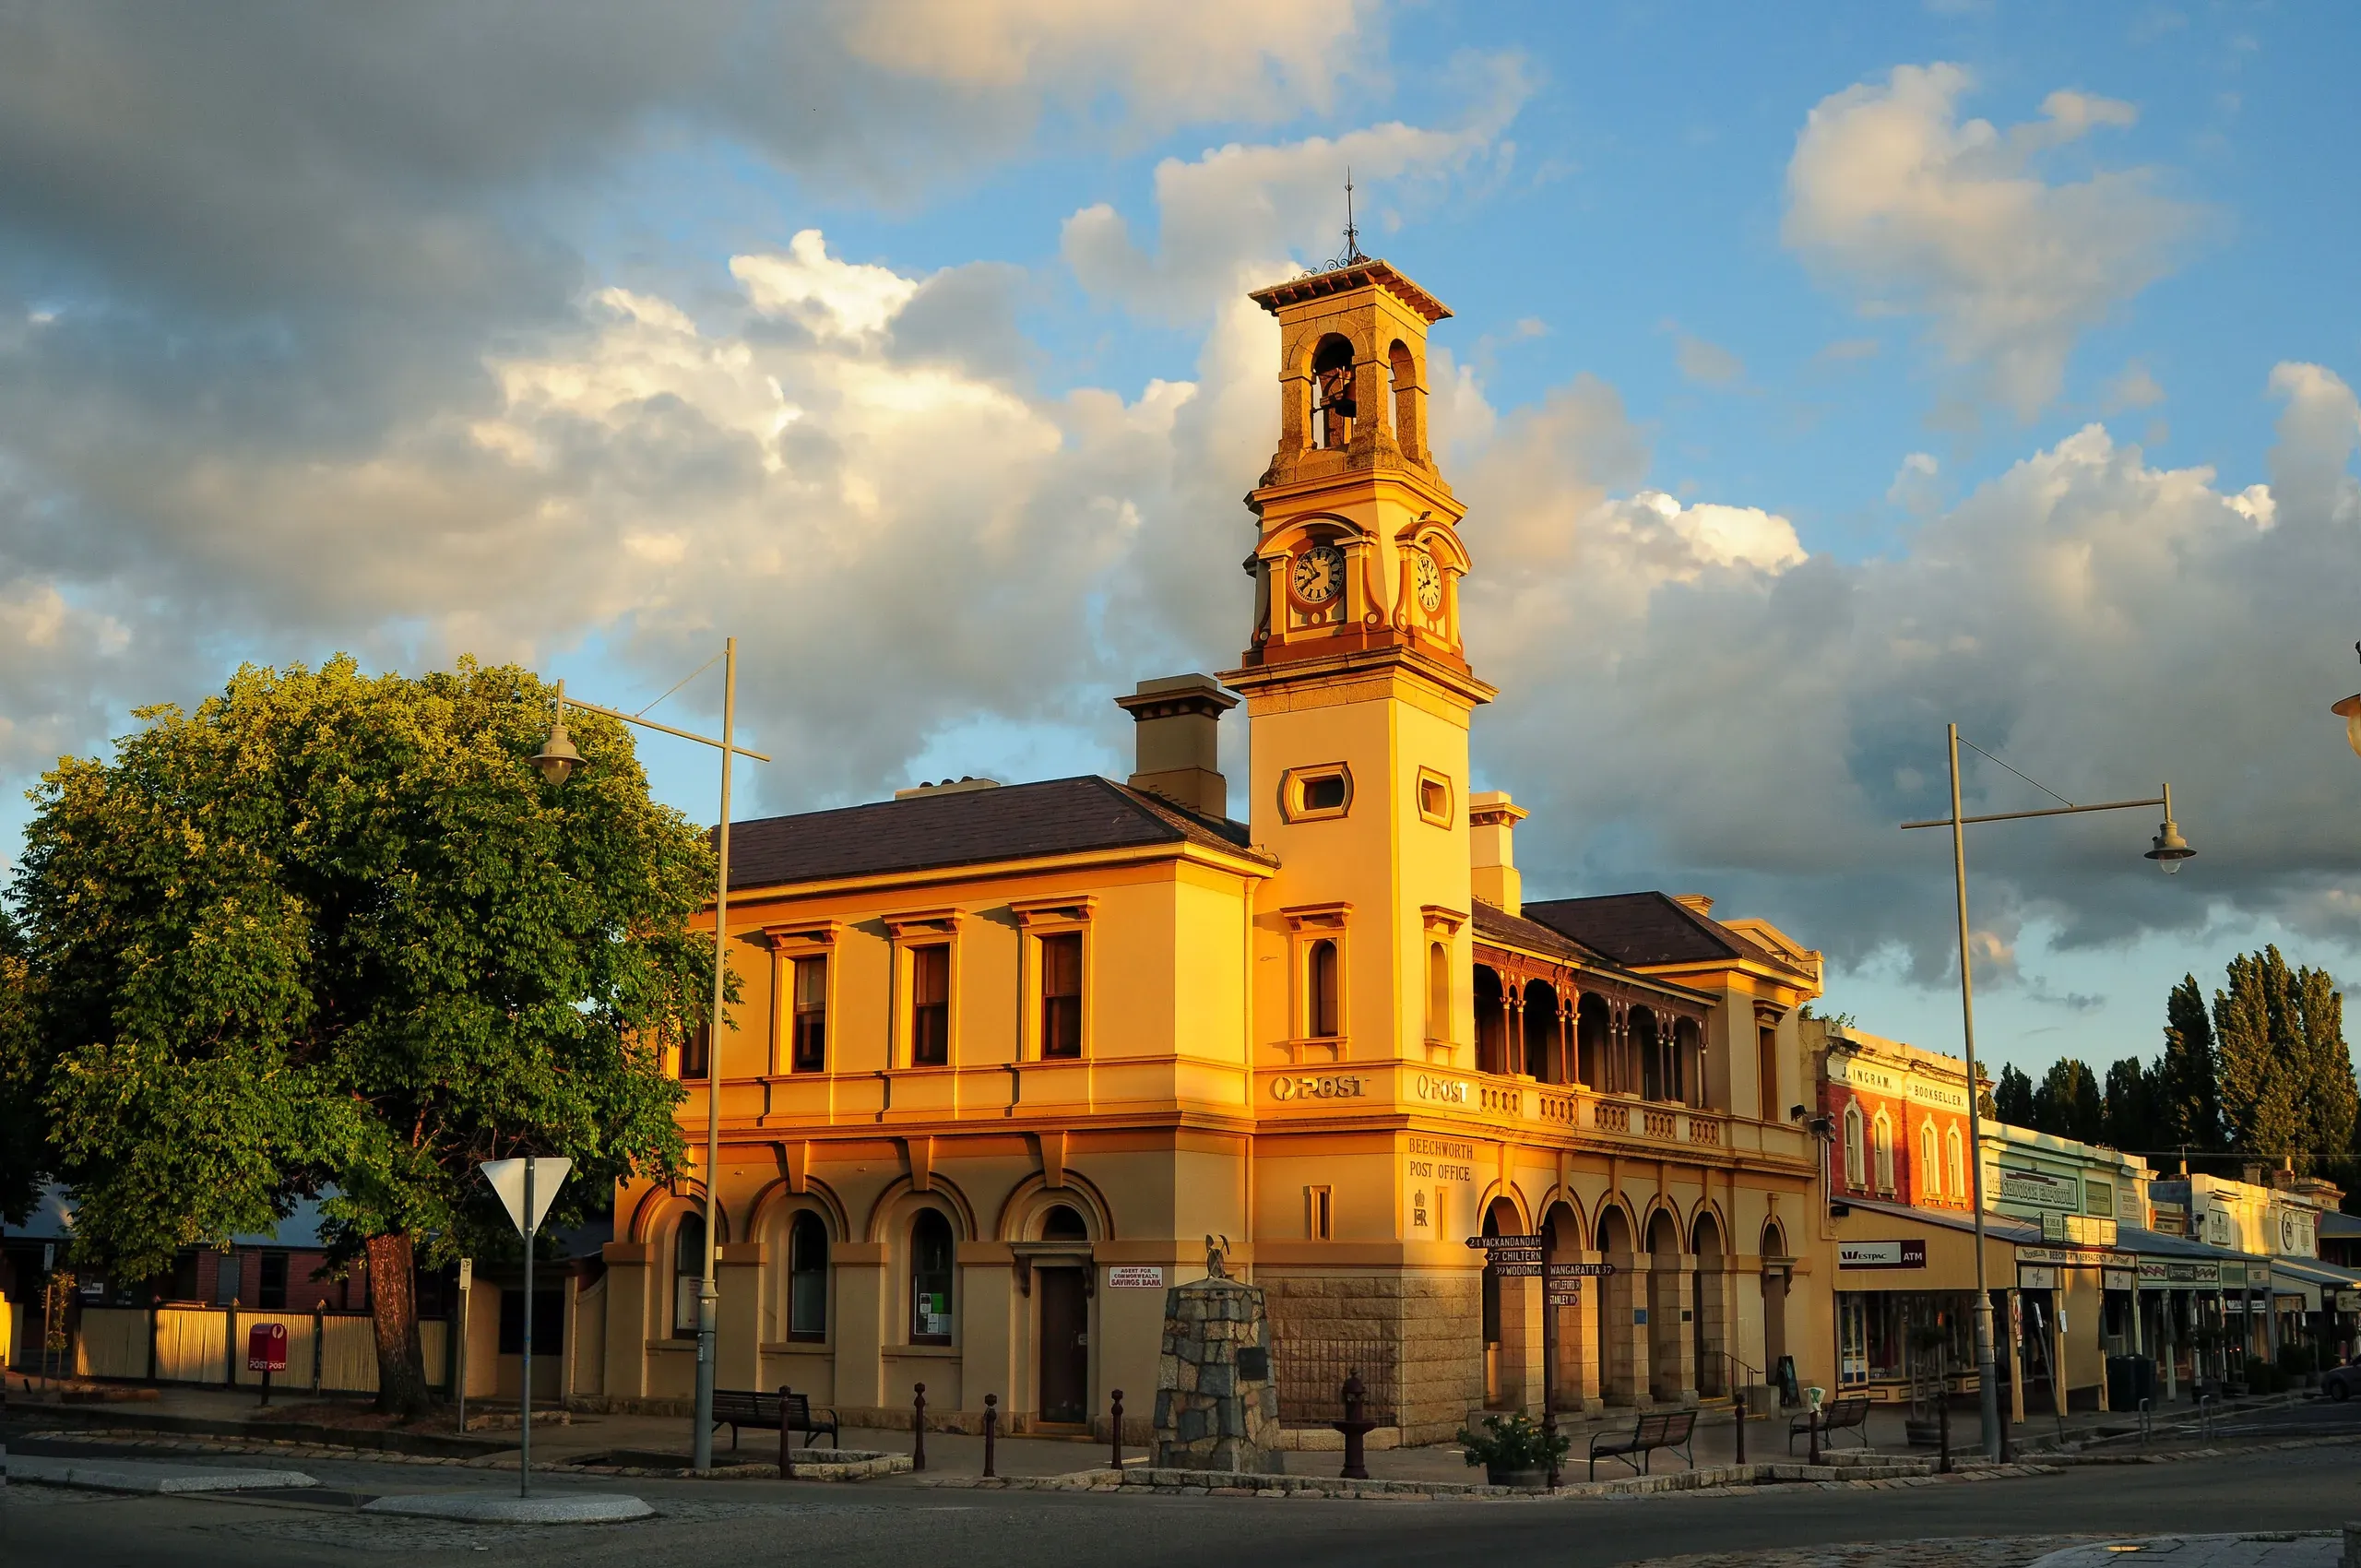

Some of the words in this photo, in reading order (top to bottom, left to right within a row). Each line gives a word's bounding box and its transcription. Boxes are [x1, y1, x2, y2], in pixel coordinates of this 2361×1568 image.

[1298, 1075, 1370, 1099] POST
[1431, 1077, 1469, 1104] POST
[1408, 1137, 1474, 1160] BEECHWORTH
[1409, 1160, 1433, 1178] POST
[1438, 1164, 1471, 1182] OFFICE
[1481, 1237, 1541, 1248] YACKANDANDAH
[1488, 1252, 1500, 1261] 27
[1501, 1251, 1541, 1261] CHILTERN
[1903, 1253, 1923, 1261] ATM
[1495, 1266, 1506, 1276] 39
[1506, 1265, 1542, 1276] WODONGA
[1549, 1265, 1600, 1276] WANGARATTA
[1601, 1265, 1612, 1275] 37
[250, 1360, 267, 1369] POST
